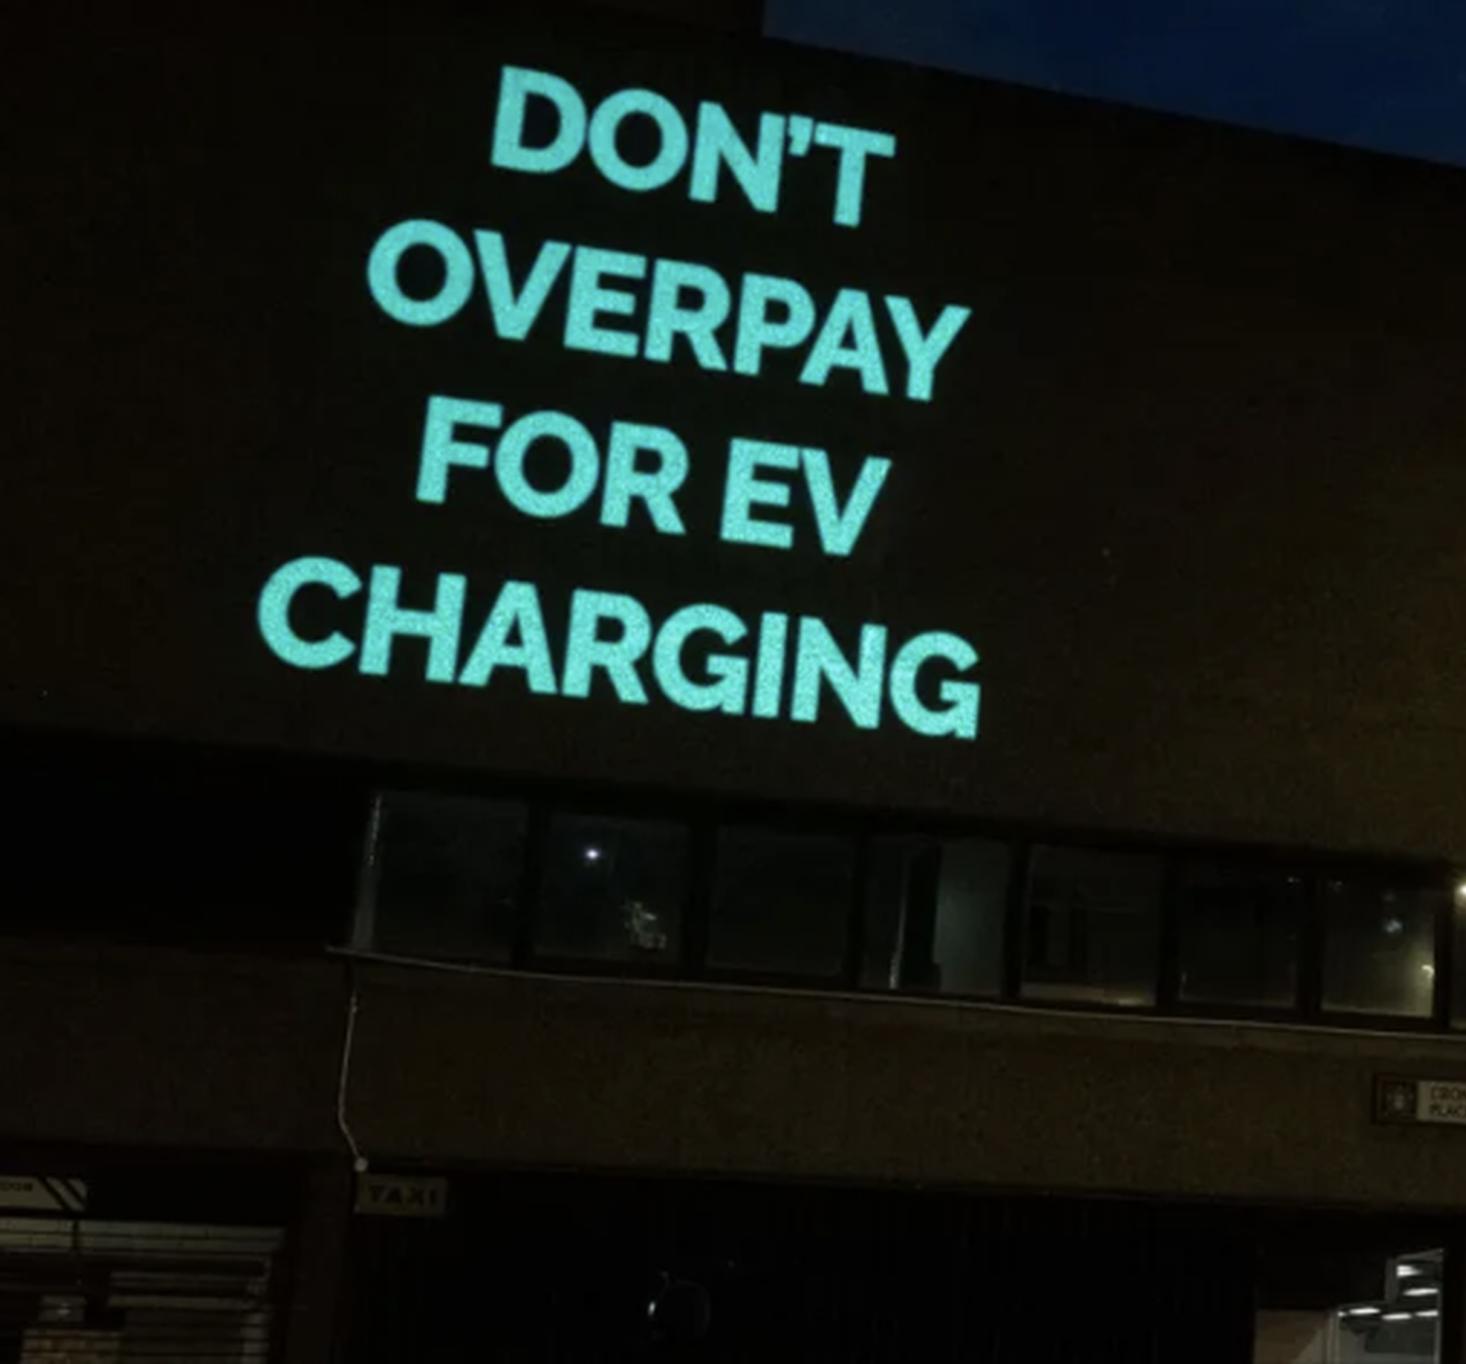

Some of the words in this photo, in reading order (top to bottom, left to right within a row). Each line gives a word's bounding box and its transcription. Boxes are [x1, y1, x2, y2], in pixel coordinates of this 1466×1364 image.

[490, 64, 897, 228] DON’T
[366, 218, 973, 402] OVERPAY
[415, 395, 690, 536] FOR
[719, 437, 893, 557] EV
[256, 555, 982, 740] CHARGING
[368, 1182, 436, 1206] TAXI
